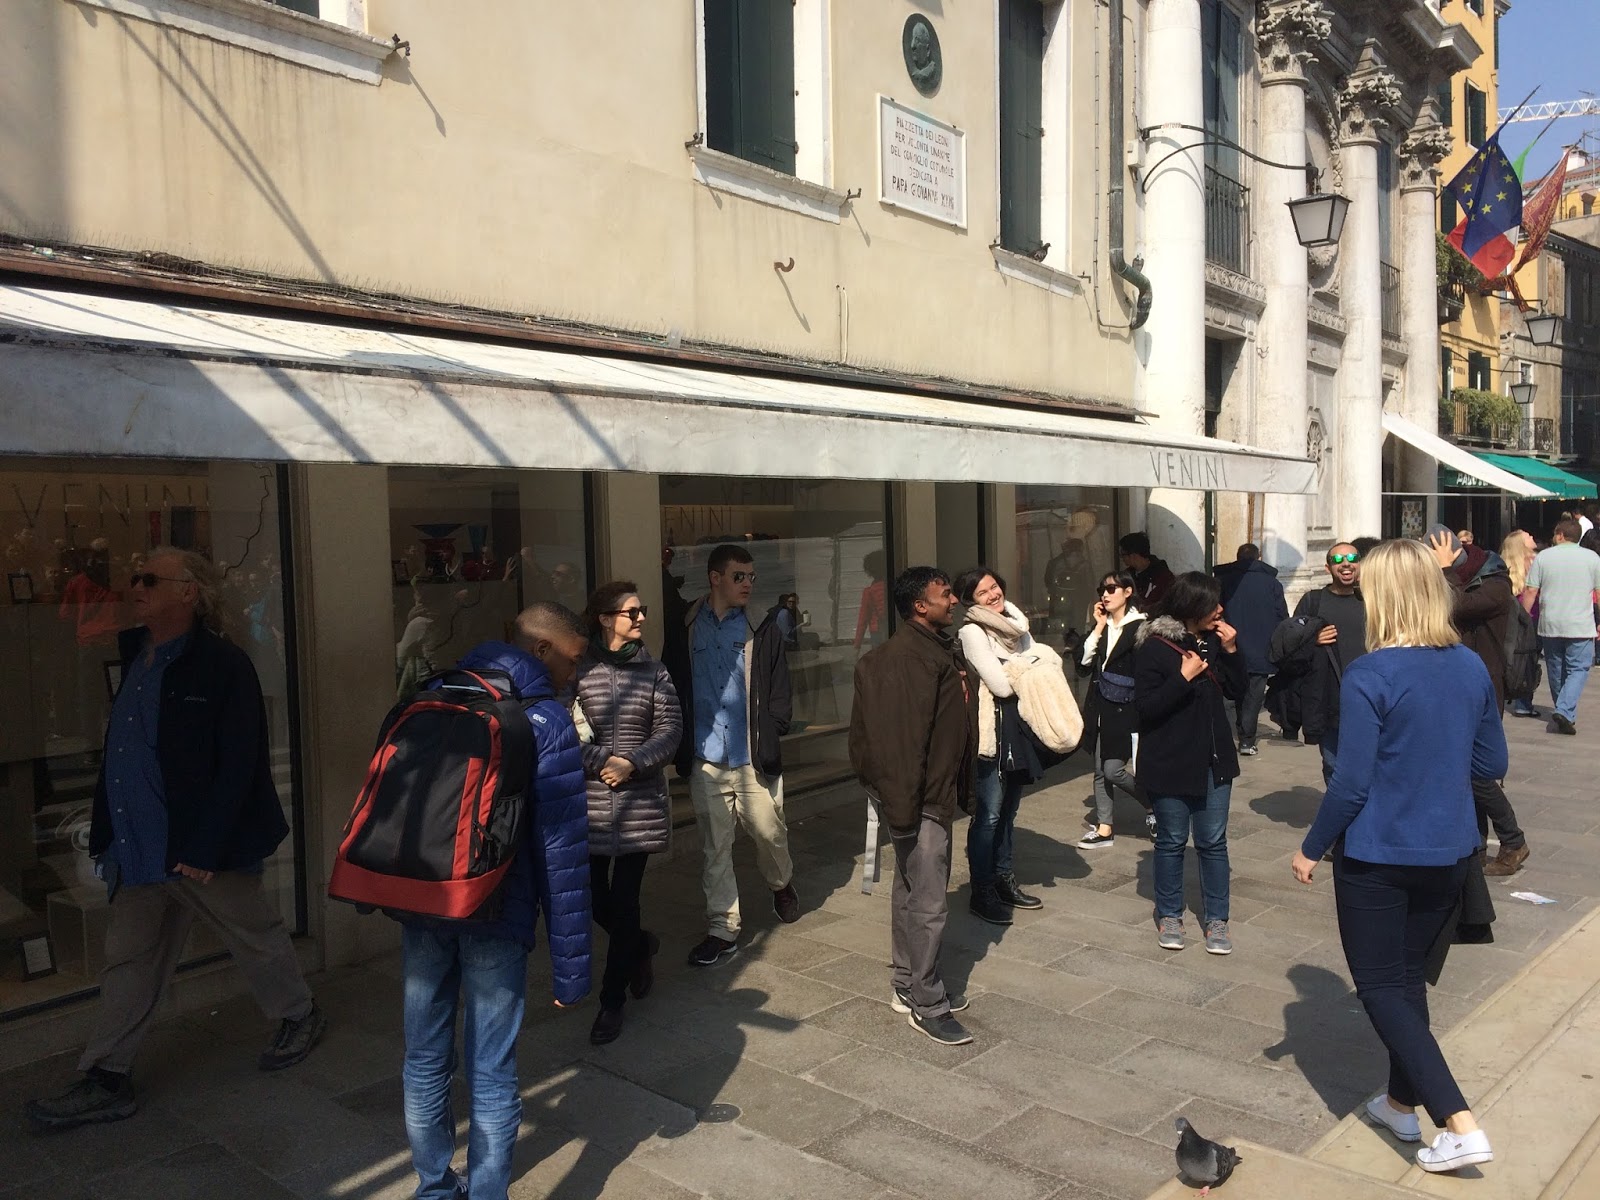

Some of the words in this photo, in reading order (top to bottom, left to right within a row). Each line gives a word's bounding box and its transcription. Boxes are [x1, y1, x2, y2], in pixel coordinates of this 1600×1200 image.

[896, 116, 923, 135] PIAZZETTA
[896, 131, 905, 144] PER
[890, 144, 900, 157] DEL
[892, 175, 907, 193] PAPA
[1149, 450, 1228, 488] VENINI
[662, 506, 733, 533] ENINI
